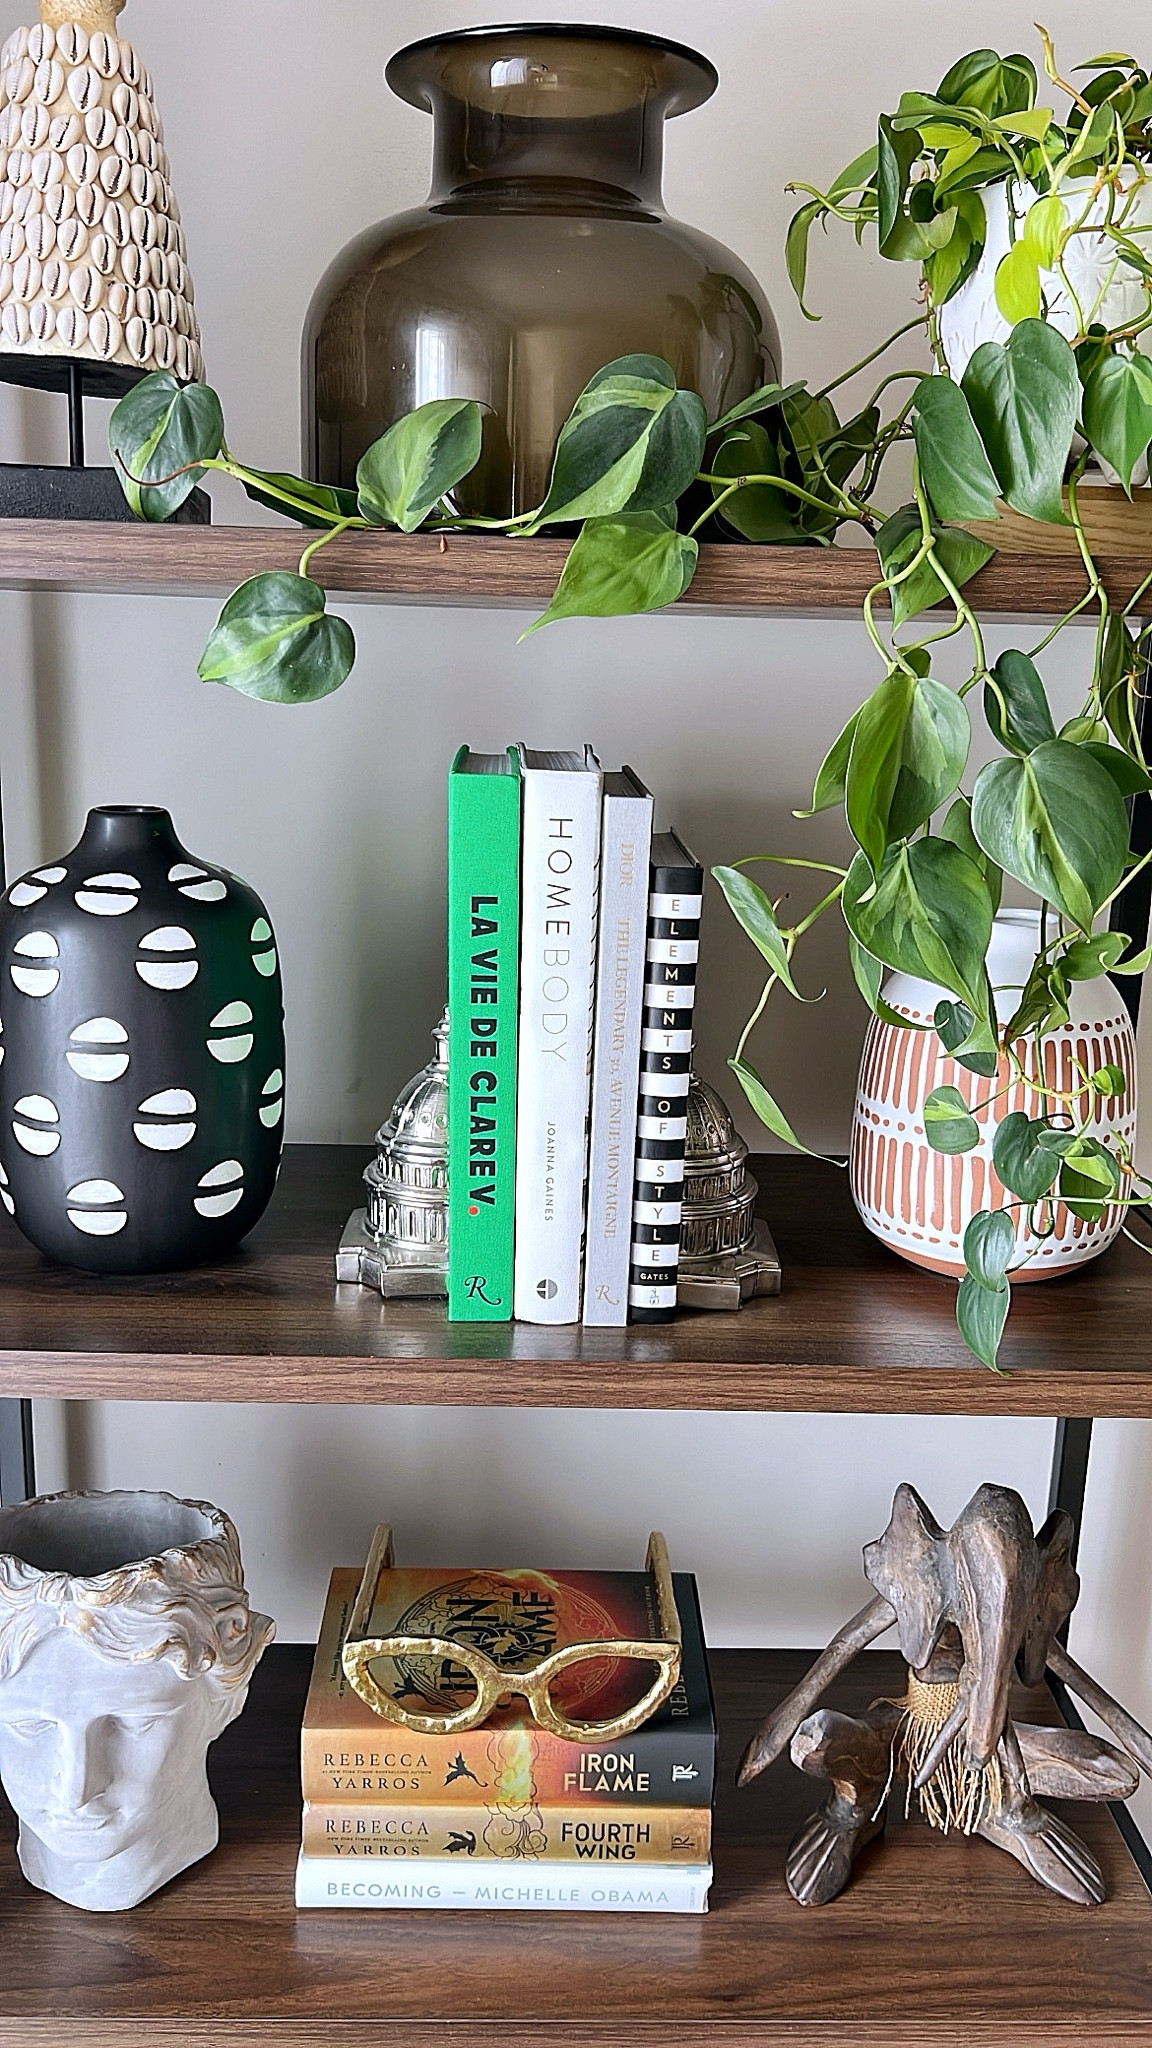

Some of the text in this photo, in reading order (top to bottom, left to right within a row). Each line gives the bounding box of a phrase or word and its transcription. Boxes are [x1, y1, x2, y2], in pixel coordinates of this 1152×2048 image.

[620, 843, 635, 888] DIOR
[471, 896, 499, 938] LA
[616, 918, 631, 952] THE
[541, 818, 573, 1061] HOMEBODY
[470, 949, 498, 1004] VIE
[611, 956, 629, 1055] LEGENDARY
[469, 1018, 497, 1057] DE
[652, 898, 681, 1261] ELEMENTS OF STYLE
[469, 1070, 497, 1177] CLARE
[608, 1079, 624, 1141] AVENUE
[544, 1121, 556, 1222] JOANNA GAINES
[604, 1144, 621, 1239] MONTAIGNE
[639, 1272, 669, 1281] GATES
[324, 1753, 429, 1767] REBECCA
[580, 1753, 635, 1773] IRON
[333, 1777, 420, 1789] YARROS
[564, 1773, 650, 1792] FLAME
[326, 1819, 429, 1835] REBECCA
[561, 1822, 650, 1843] FOURTH
[334, 1844, 420, 1856] YARROS
[575, 1844, 636, 1860] WING
[327, 1882, 442, 1899] BECOMING
[475, 1886, 580, 1902] MICHELLE
[591, 1889, 669, 1903] OBAMA
